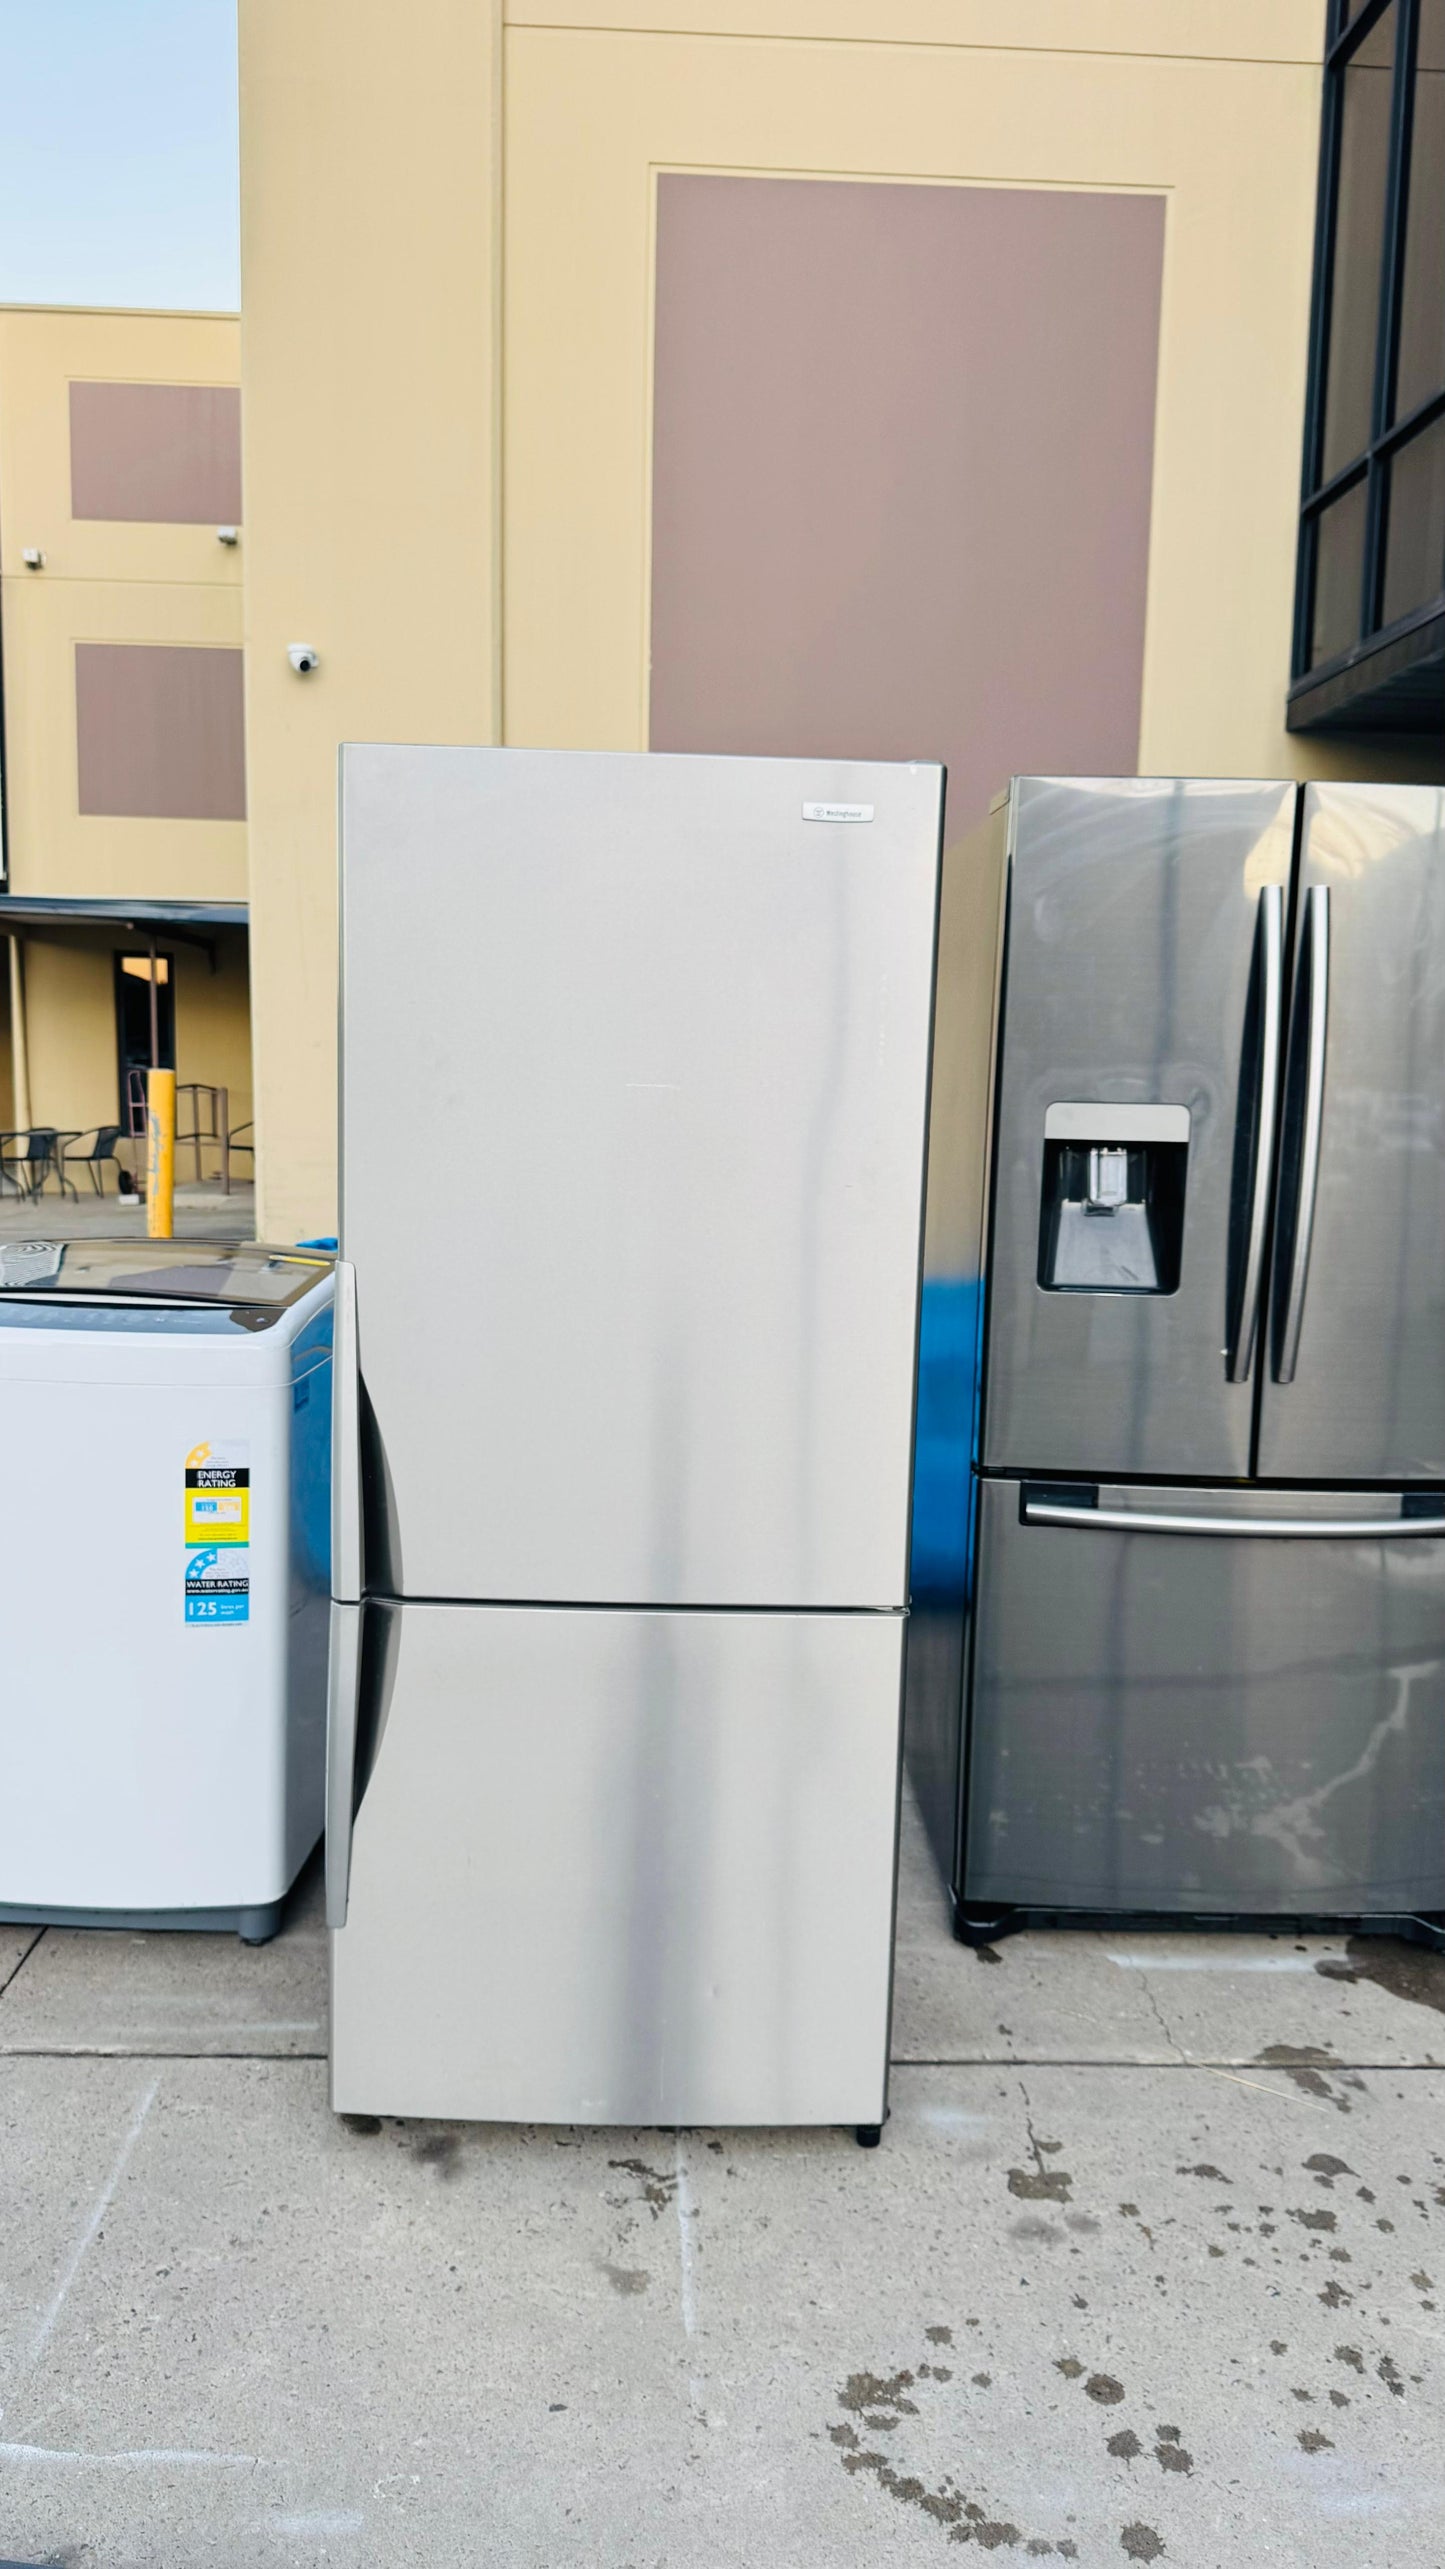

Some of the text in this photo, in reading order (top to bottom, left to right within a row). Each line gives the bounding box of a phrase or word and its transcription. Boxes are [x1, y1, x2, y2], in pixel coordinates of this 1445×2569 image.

[197, 1471, 237, 1479] ENERGY
[197, 1479, 236, 1488] RATING
[189, 1601, 217, 1616] 125
